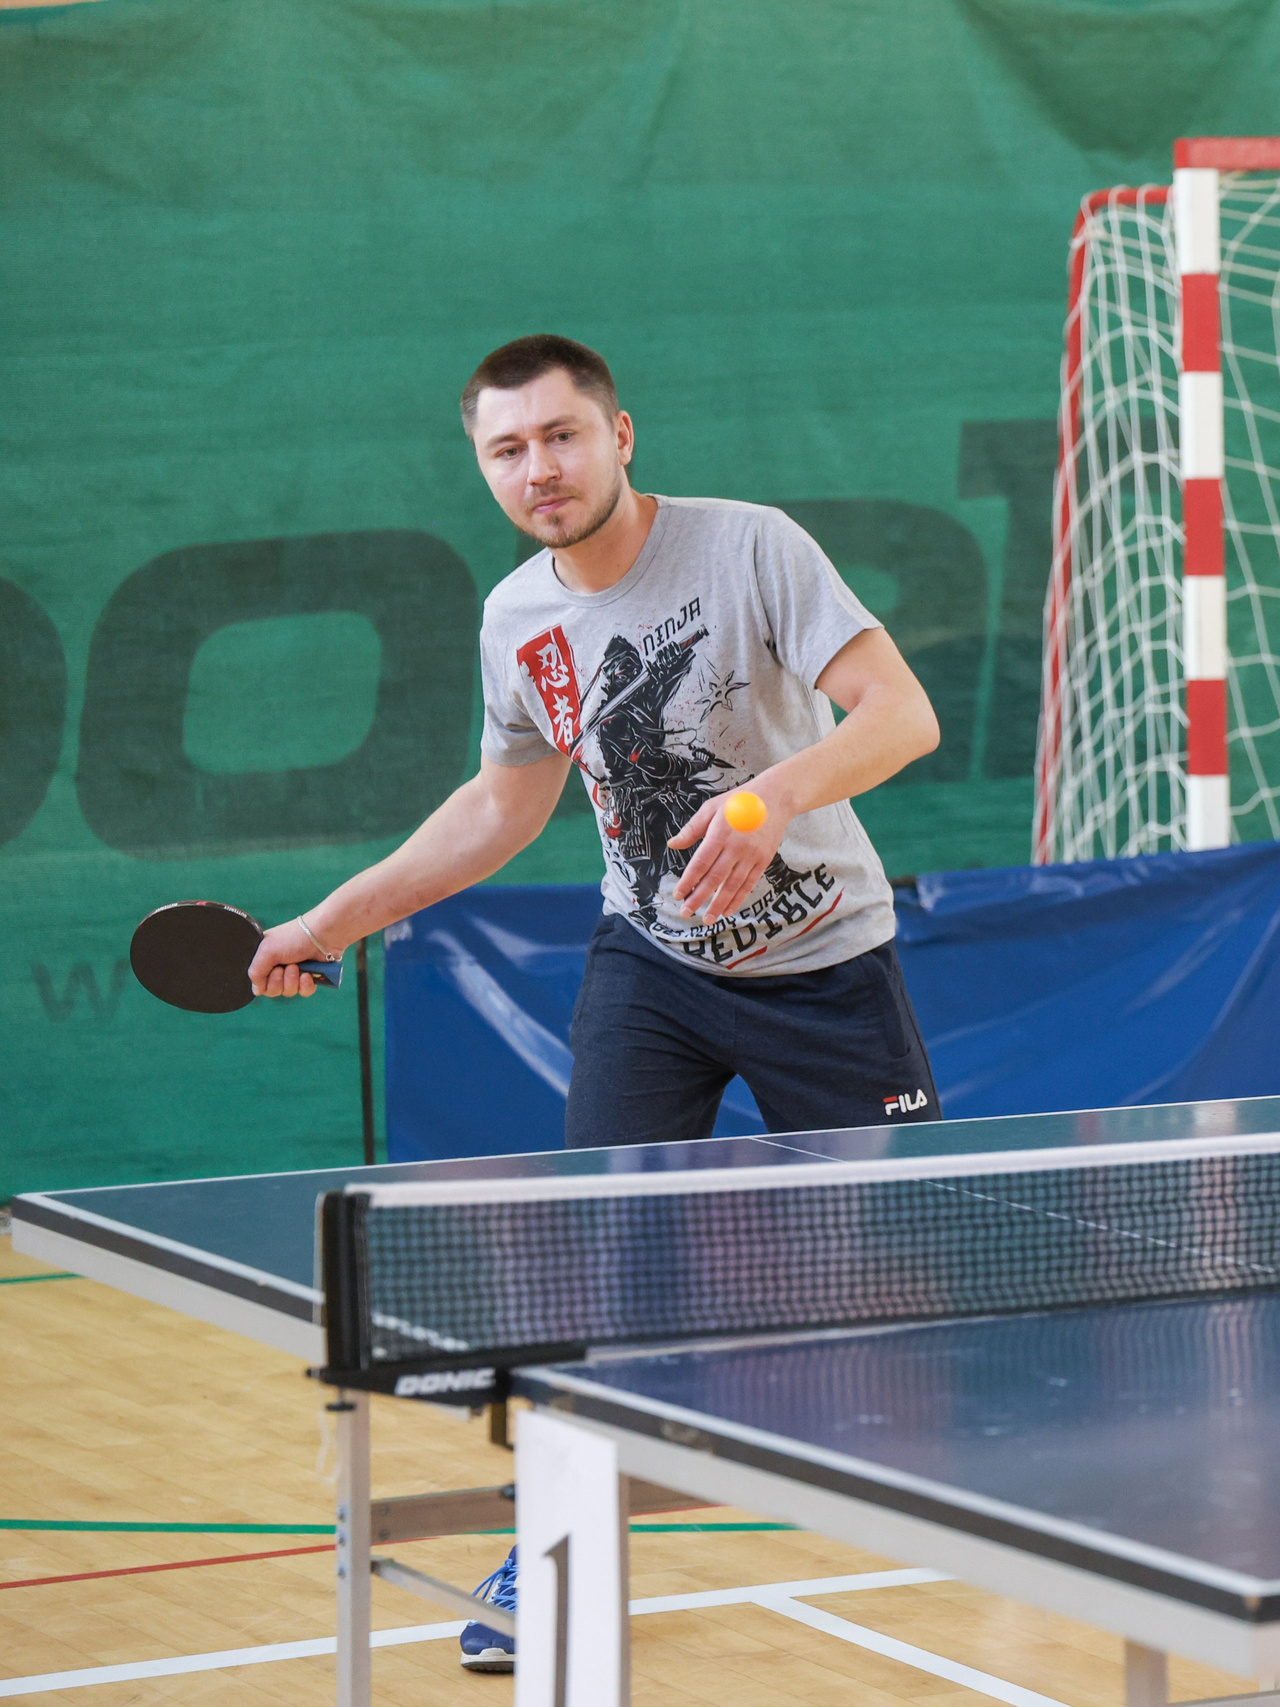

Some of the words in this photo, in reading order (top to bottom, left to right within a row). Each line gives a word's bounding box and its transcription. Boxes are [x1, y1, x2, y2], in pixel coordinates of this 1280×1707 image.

[643, 597, 700, 656] NINJA
[536, 643, 574, 746] 忍者
[882, 1088, 928, 1116] FILA
[394, 1367, 497, 1397] DONIC
